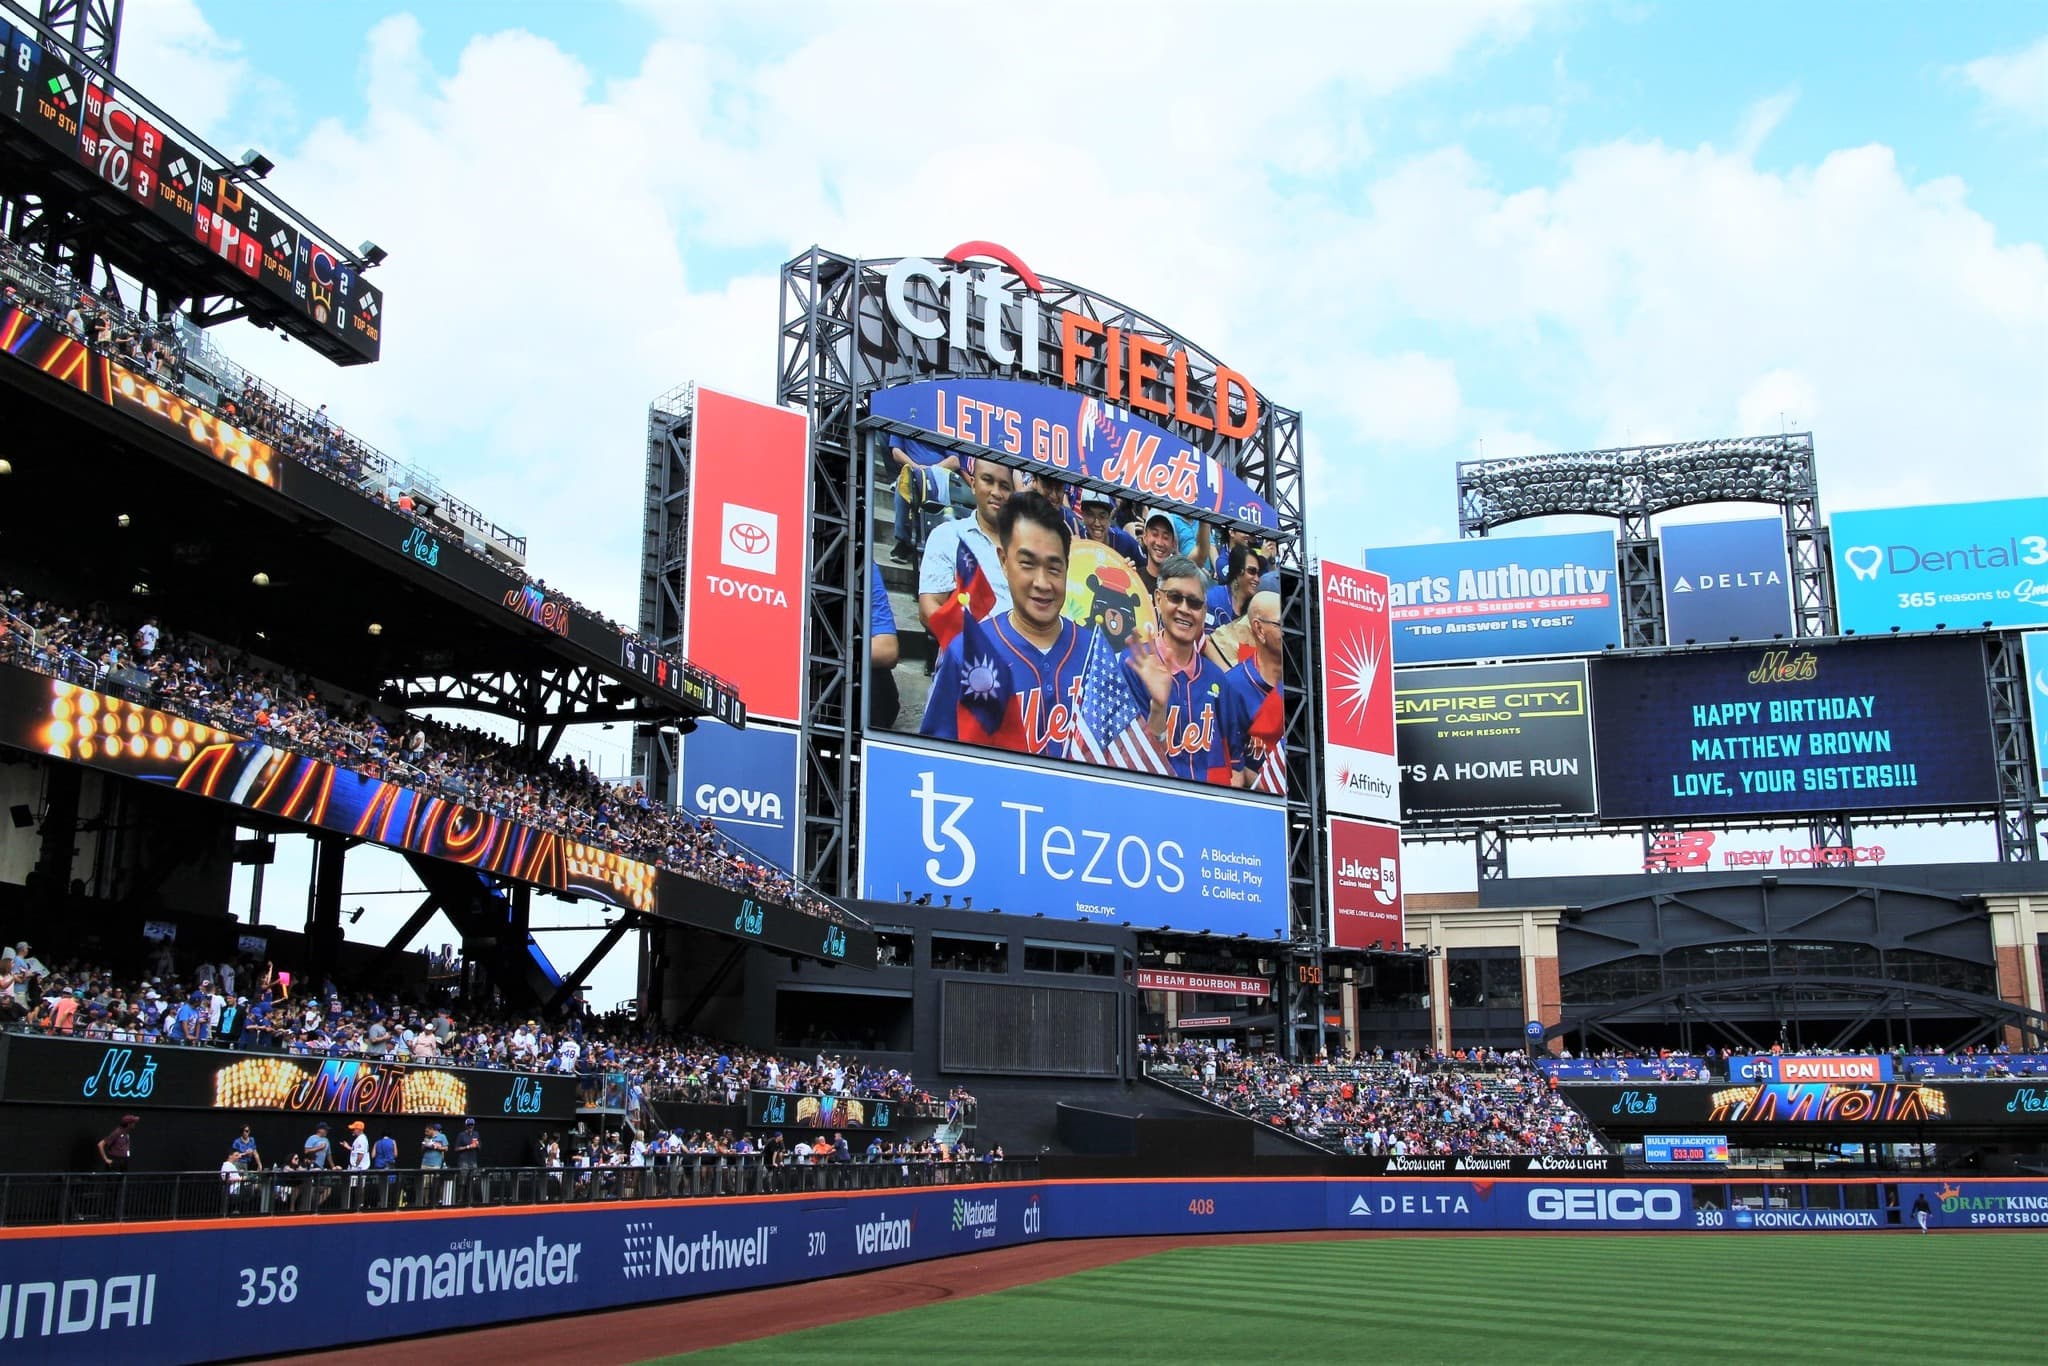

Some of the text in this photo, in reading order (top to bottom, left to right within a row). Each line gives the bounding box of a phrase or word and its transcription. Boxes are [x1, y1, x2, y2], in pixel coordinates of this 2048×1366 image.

[18, 43, 31, 72] 8
[16, 85, 24, 113] 1
[39, 99, 77, 136] TOP 9TH
[87, 95, 100, 117] 40
[142, 132, 154, 158] 2
[82, 134, 96, 157] 46
[138, 170, 149, 197] 3
[160, 182, 176, 202] TOP
[201, 176, 214, 196] 59
[248, 207, 258, 232] 2
[197, 214, 209, 233] 43
[245, 243, 254, 268] 0
[264, 253, 277, 271] TOP
[340, 272, 348, 296] 2
[337, 306, 345, 329] 0
[353, 315, 365, 331] TOP
[886, 257, 1039, 374] citi
[1062, 310, 1259, 440] FIELD
[936, 389, 1069, 467] LET'S GO
[1102, 429, 1201, 504] Mets
[1238, 506, 1262, 526] citi
[402, 527, 439, 566] Mets
[706, 575, 788, 609] TOYOTA
[1390, 576, 1451, 606] arts
[1457, 563, 1607, 601] Authority
[1700, 571, 1780, 589] DELTA
[1327, 574, 1385, 613] Affinity
[1898, 592, 1936, 608] 365
[1938, 589, 1993, 603] reasons
[1996, 589, 2010, 600] to
[1391, 596, 1602, 618] uto Parts Super Stores
[1446, 620, 1508, 633] Answer
[1512, 618, 1527, 629] Is
[1748, 650, 1818, 684] Mets
[706, 686, 713, 708] B
[720, 694, 727, 716] S
[1395, 692, 1570, 714] EMPIRE CITY
[1692, 695, 1875, 727] HAPPY BIRTHDAY
[1445, 711, 1512, 723] CASINO
[1476, 727, 1521, 736] RESORTS
[1691, 730, 1892, 761] MATTHEW BROWN
[1398, 758, 1578, 783] T'S A HOME RUN
[1673, 763, 1918, 798] LOVE, YOUR SISTERS!!!
[1350, 773, 1391, 798] Affinity
[695, 783, 782, 819] GOYA
[1001, 801, 1185, 893] Tezos
[1201, 848, 1262, 867] A Blockchain
[1724, 844, 1886, 866] new balance
[1201, 866, 1263, 888] to Build, Play
[1338, 857, 1379, 881] Jake's
[1383, 870, 1395, 882] 58
[1201, 885, 1263, 903] & Collect on.
[735, 899, 763, 935] Mets
[1075, 901, 1116, 916] tezos.nyc
[1139, 973, 1261, 992] IM BEAM BOURBON BAR
[1527, 1025, 1540, 1034] citi
[83, 1048, 157, 1098] Mets
[1785, 1062, 1873, 1078] PAVILION
[504, 1076, 543, 1113] Mets
[1612, 1091, 1657, 1115] Mets
[1396, 1156, 1446, 1171] Coors LIGHT
[1464, 1156, 1511, 1170] Coors LIGHT
[1541, 1155, 1608, 1170] Coors LIGHT
[1647, 1150, 1667, 1158] NOW
[963, 1199, 998, 1227] National
[1188, 1200, 1215, 1216] 408
[1380, 1196, 1469, 1215] DELTA
[1527, 1189, 1680, 1221] GEICO
[1696, 1212, 1723, 1226] 380
[1754, 1213, 1878, 1226] KONICA MINOLTA
[808, 1232, 826, 1256] 370
[855, 1212, 911, 1255] verizon
[974, 1226, 996, 1239] Car Rental
[655, 1226, 769, 1277] Northwell
[366, 1236, 582, 1307] smartwater
[236, 1265, 299, 1308] 358
[0, 1274, 156, 1340] NDAI
